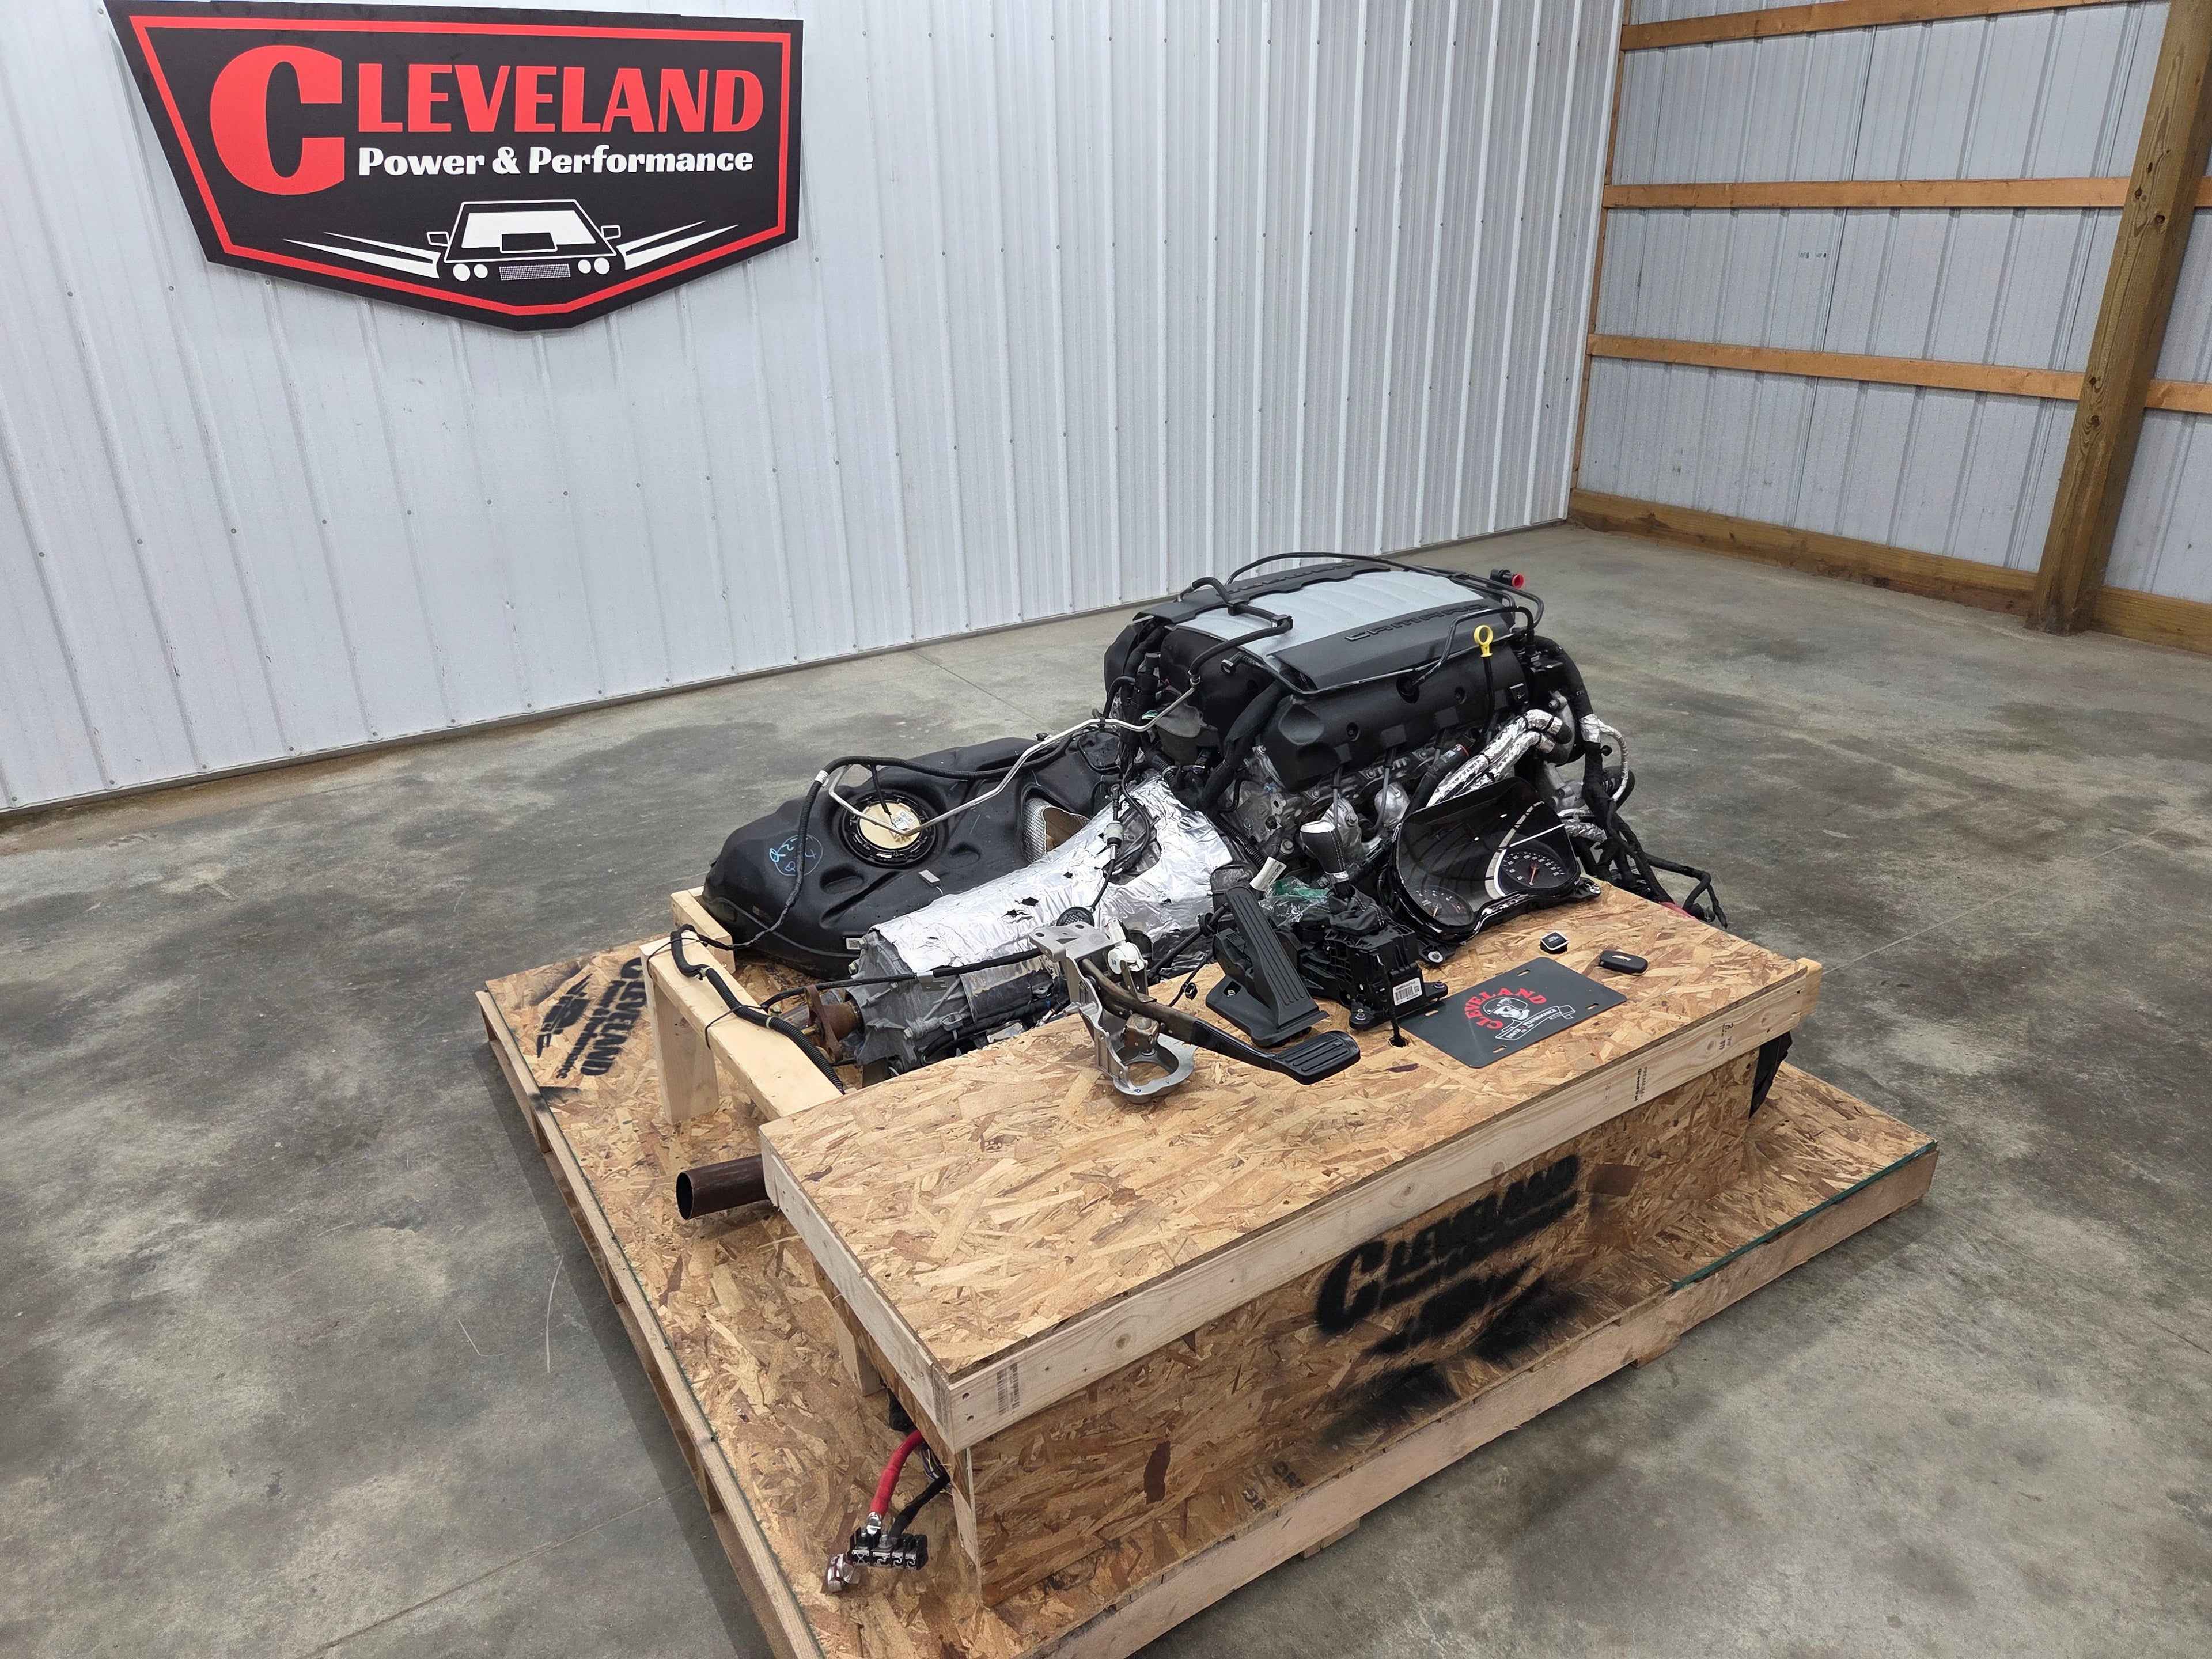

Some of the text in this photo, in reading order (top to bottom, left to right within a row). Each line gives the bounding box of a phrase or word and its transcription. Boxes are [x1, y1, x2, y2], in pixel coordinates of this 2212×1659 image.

[210, 45, 764, 195] CLEVELAND
[359, 145, 754, 176] Power & Performance
[1344, 604, 1488, 642] CAMARO
[1464, 987, 1547, 1029] CLEVELAND
